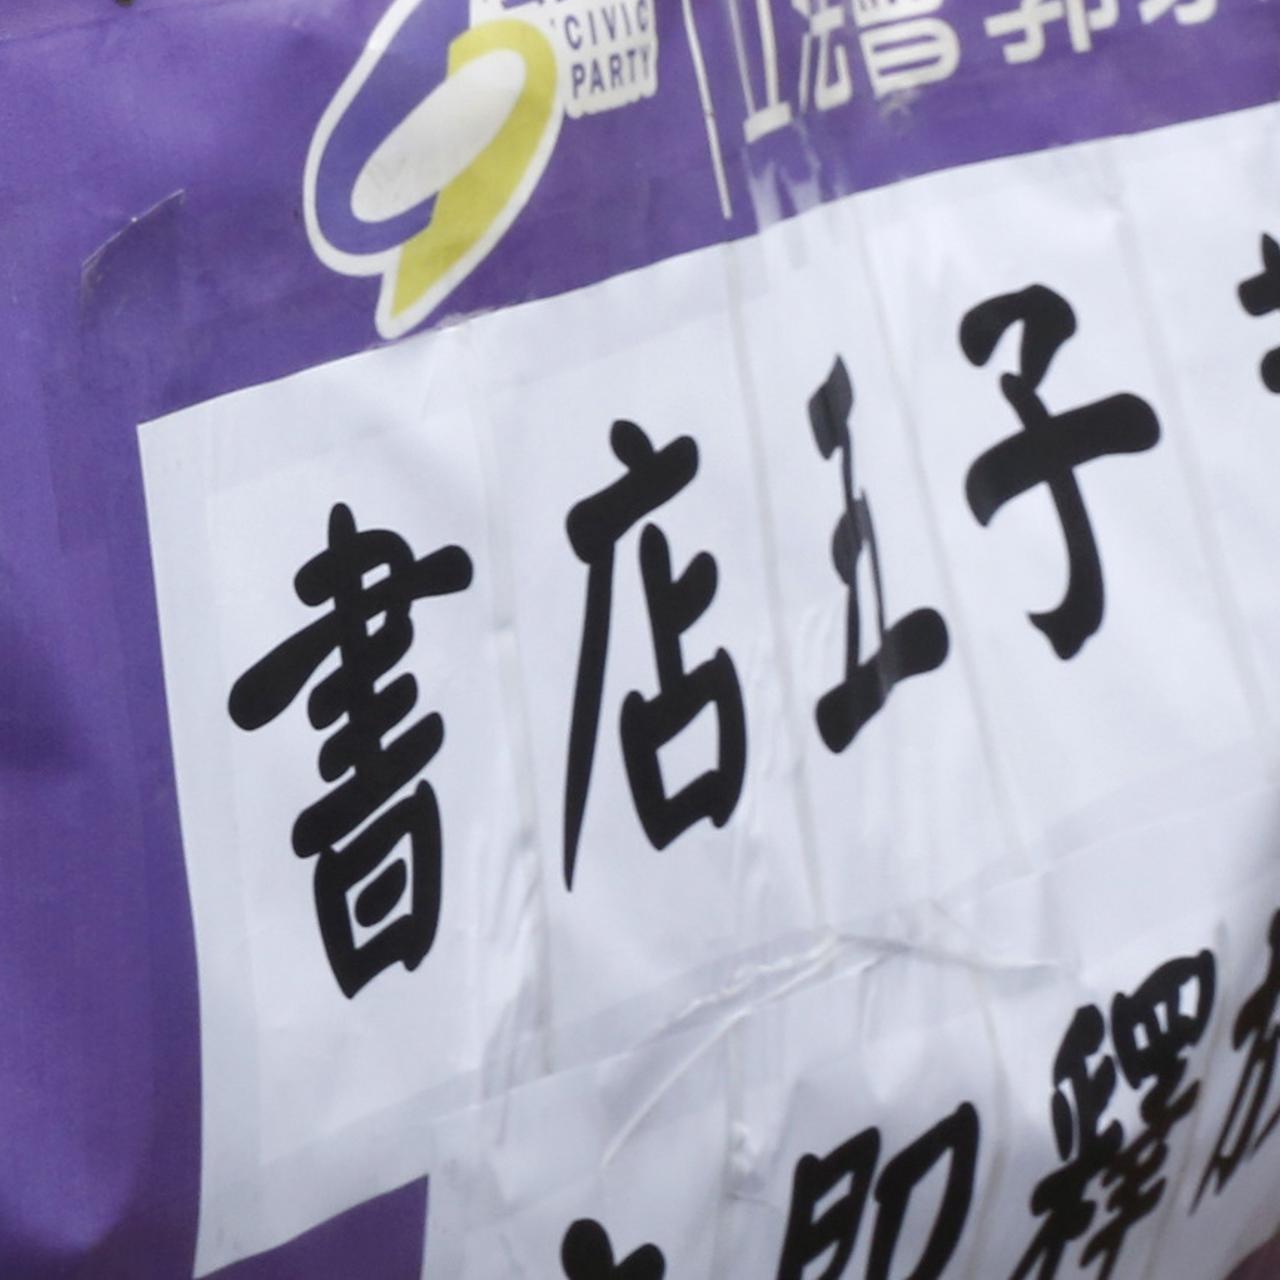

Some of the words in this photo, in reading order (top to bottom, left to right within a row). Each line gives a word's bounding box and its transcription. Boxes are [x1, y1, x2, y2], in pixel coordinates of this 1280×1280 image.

[572, 45, 651, 100] PARTY
[227, 231, 1280, 1000] 書店五子
